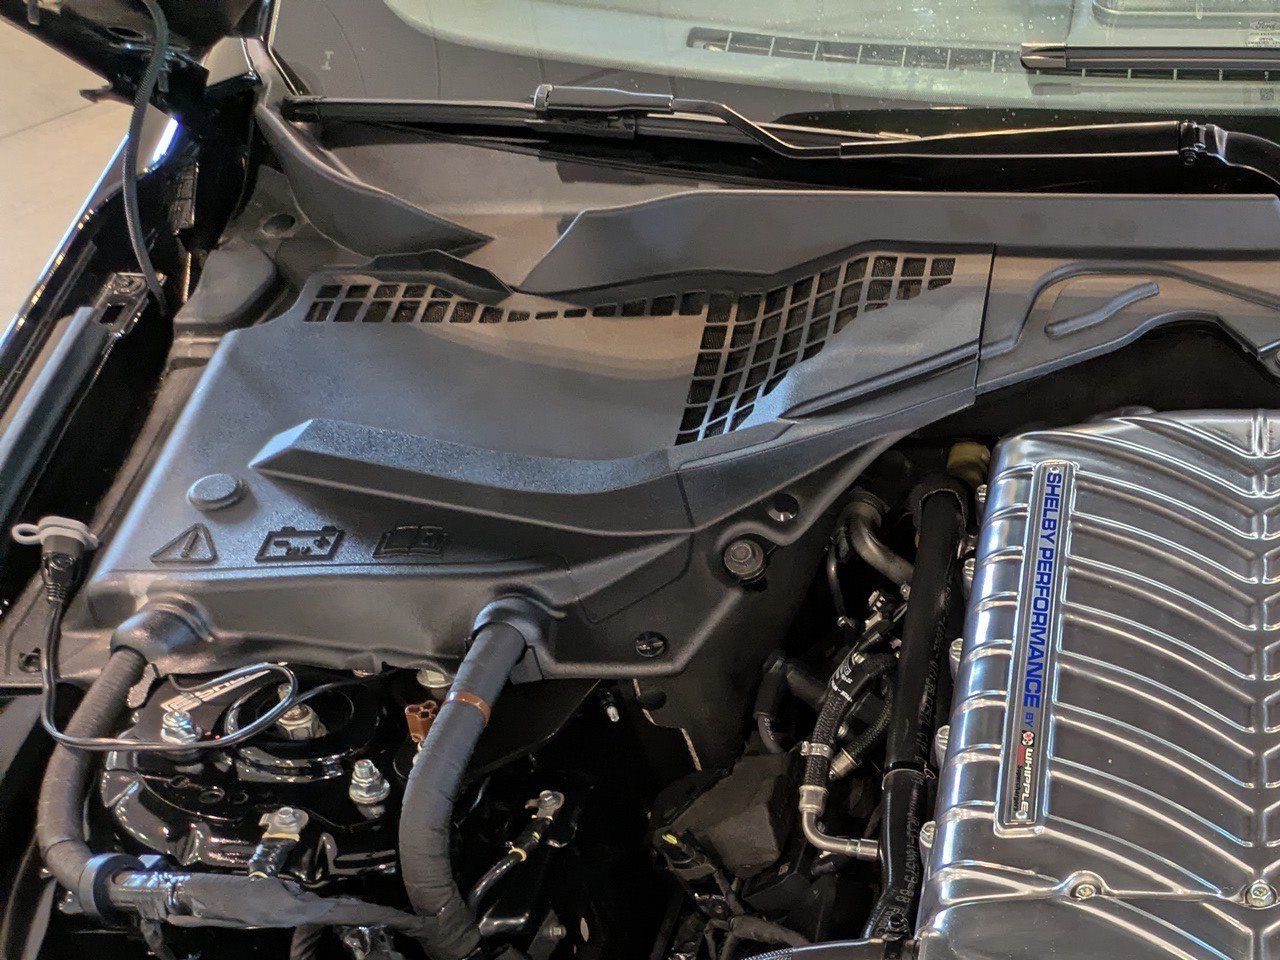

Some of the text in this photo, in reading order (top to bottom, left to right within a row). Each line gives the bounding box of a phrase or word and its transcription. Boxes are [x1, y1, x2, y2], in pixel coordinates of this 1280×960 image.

[1023, 472, 1062, 729] SHELBY PERFORMANCE BY
[1021, 747, 1034, 813] WHIPPLE
